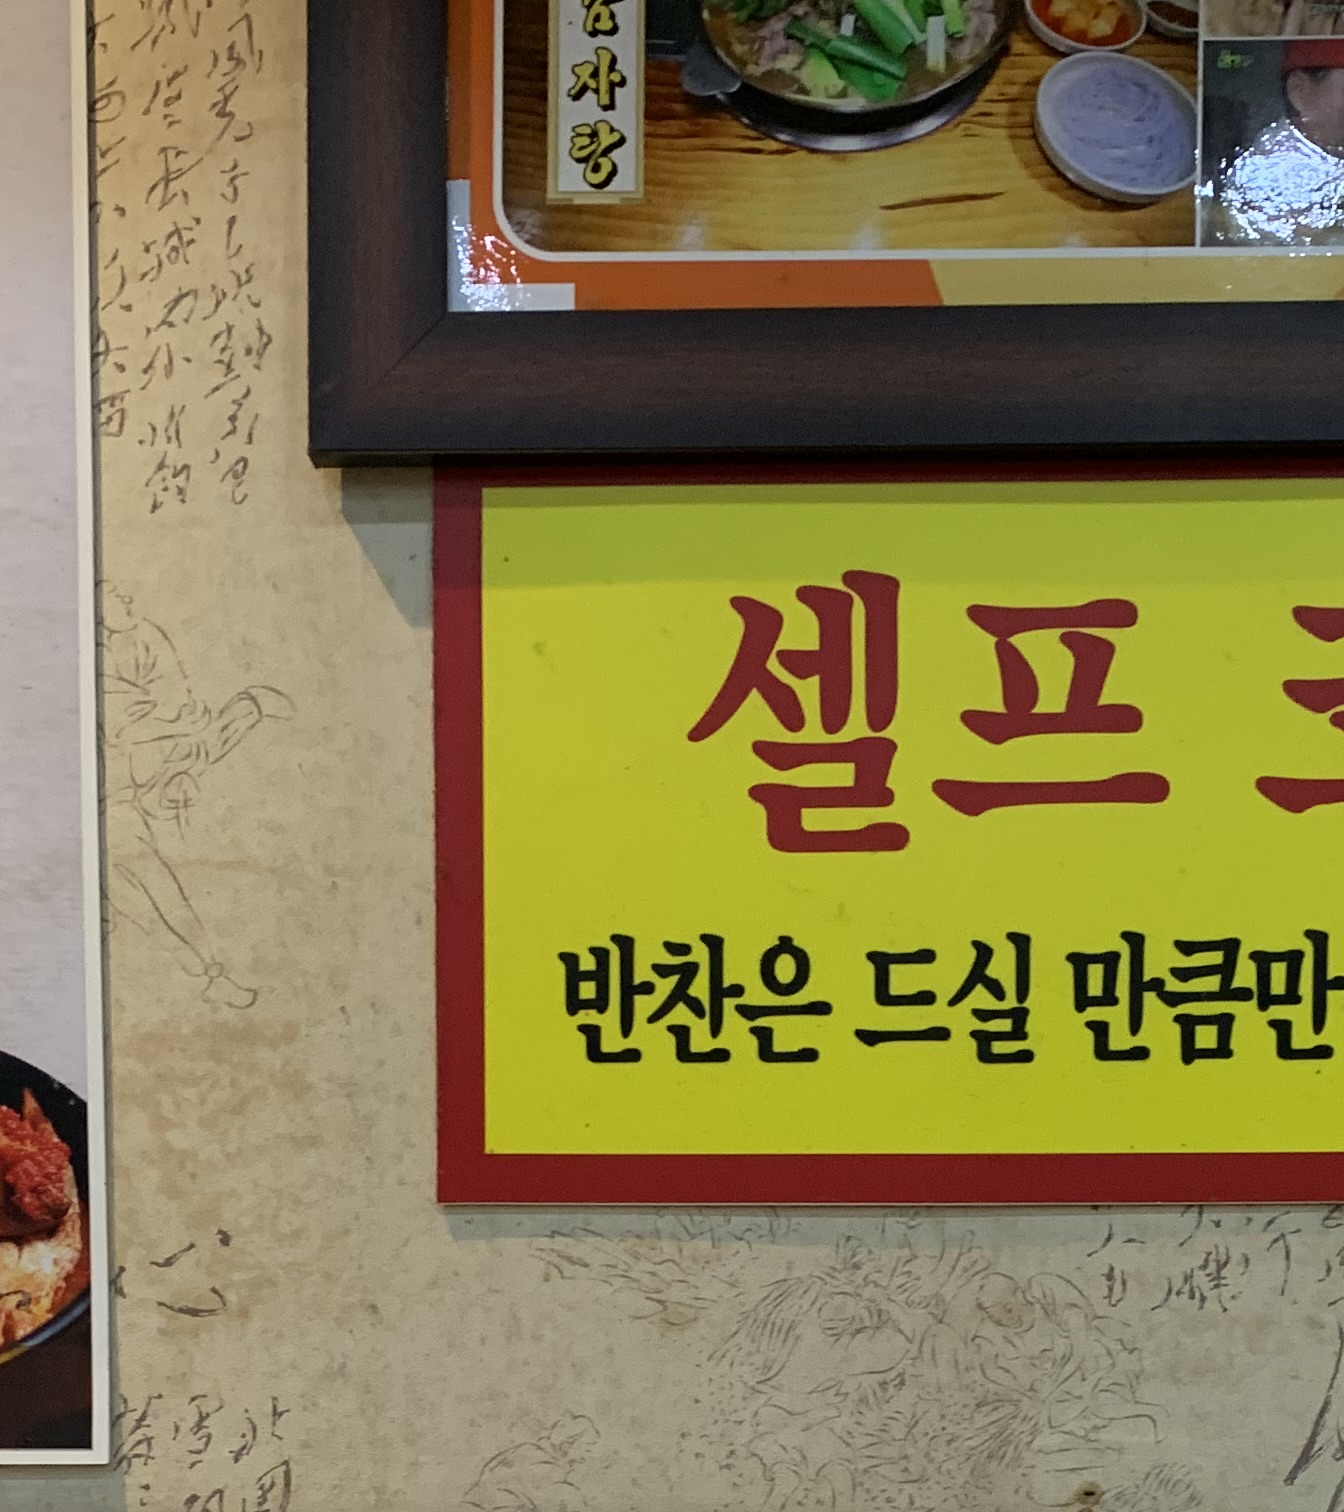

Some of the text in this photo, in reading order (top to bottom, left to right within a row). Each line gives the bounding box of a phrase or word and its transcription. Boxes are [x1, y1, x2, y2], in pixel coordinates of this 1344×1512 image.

[687, 569, 1171, 854] 셀프
[558, 933, 832, 1067] 반찬은
[855, 930, 1035, 1067] 드실
